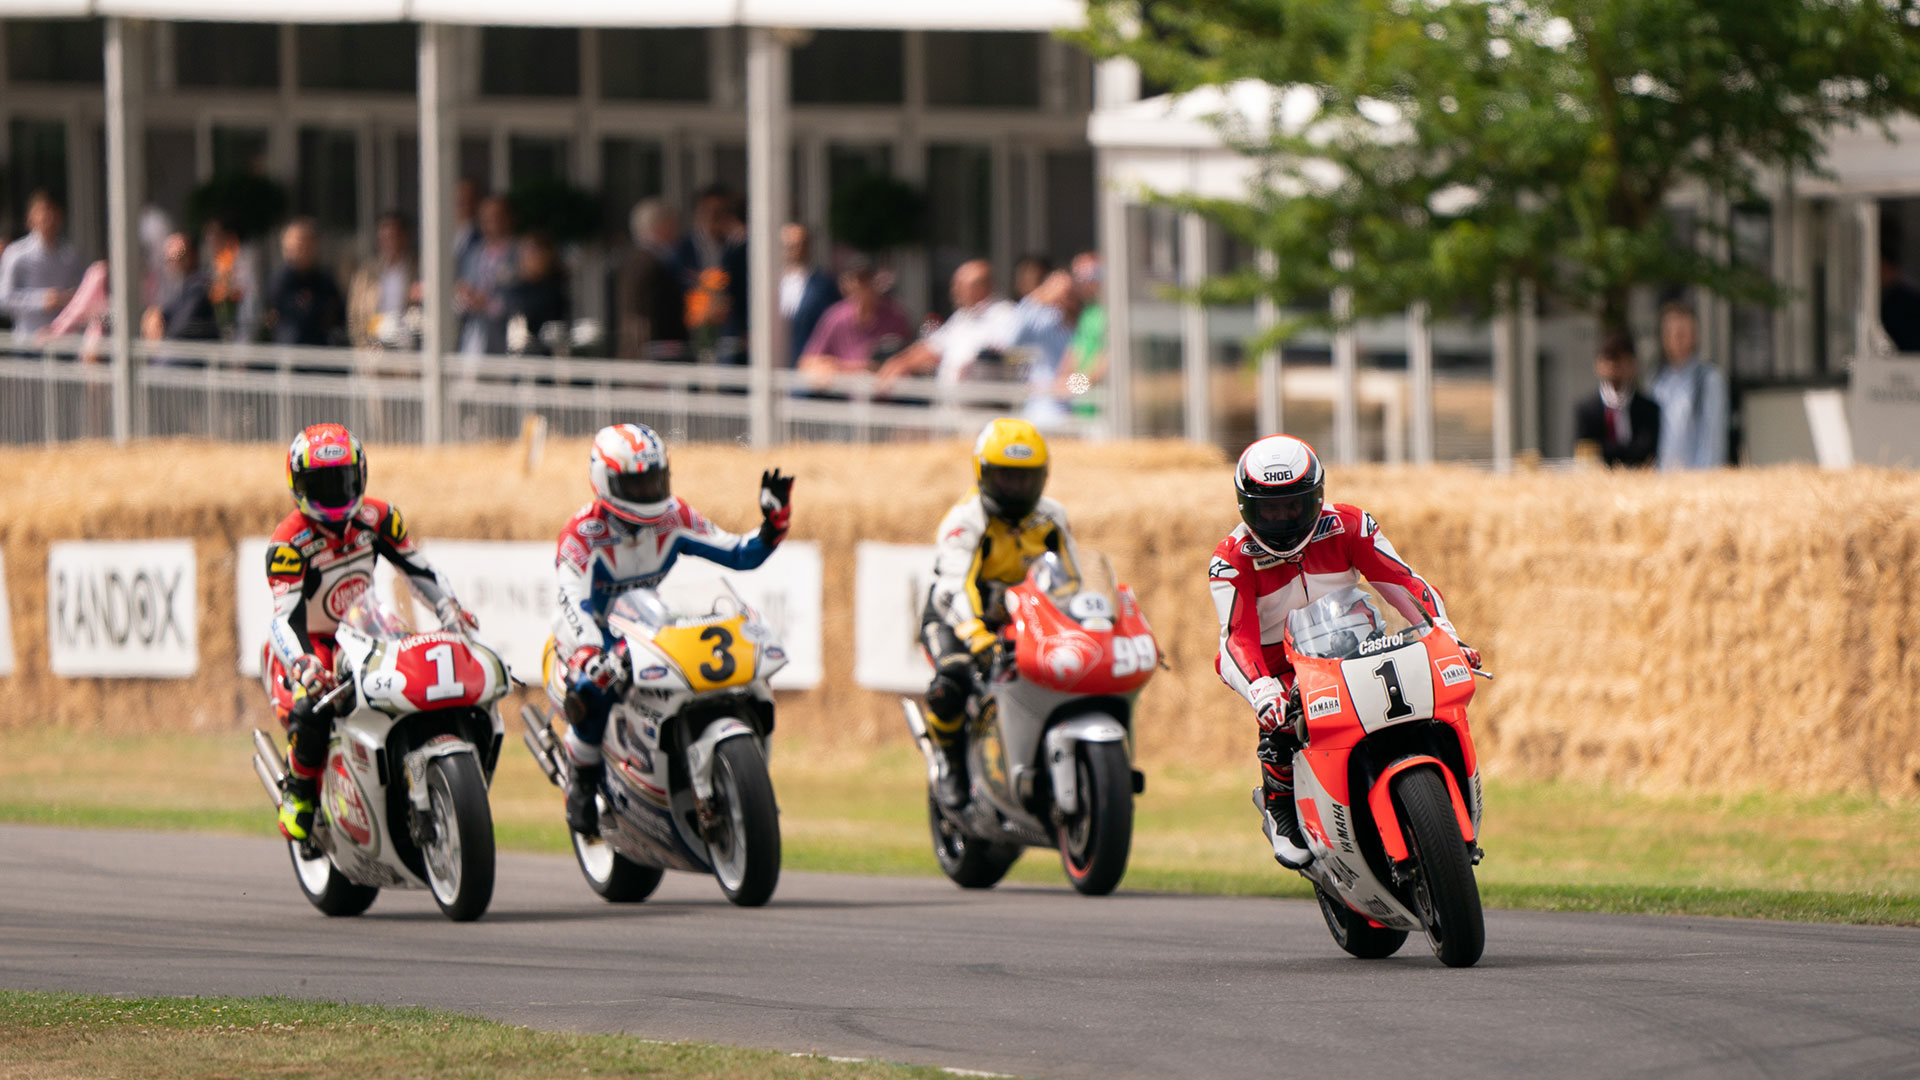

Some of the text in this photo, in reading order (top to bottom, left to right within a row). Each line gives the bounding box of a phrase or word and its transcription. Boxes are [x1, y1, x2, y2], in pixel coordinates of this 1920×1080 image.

[1263, 470, 1294, 482] SHOEI
[57, 568, 186, 649] RANDOX
[700, 627, 736, 683] 3
[1112, 634, 1157, 678] 99
[1358, 633, 1404, 655] Castrol
[374, 677, 392, 691] 54
[425, 644, 465, 701] 1
[1374, 659, 1414, 720] 1
[1442, 665, 1470, 681] YAMAHA
[1308, 699, 1340, 714] YAMAHA
[1332, 803, 1355, 855] YAMAHA
